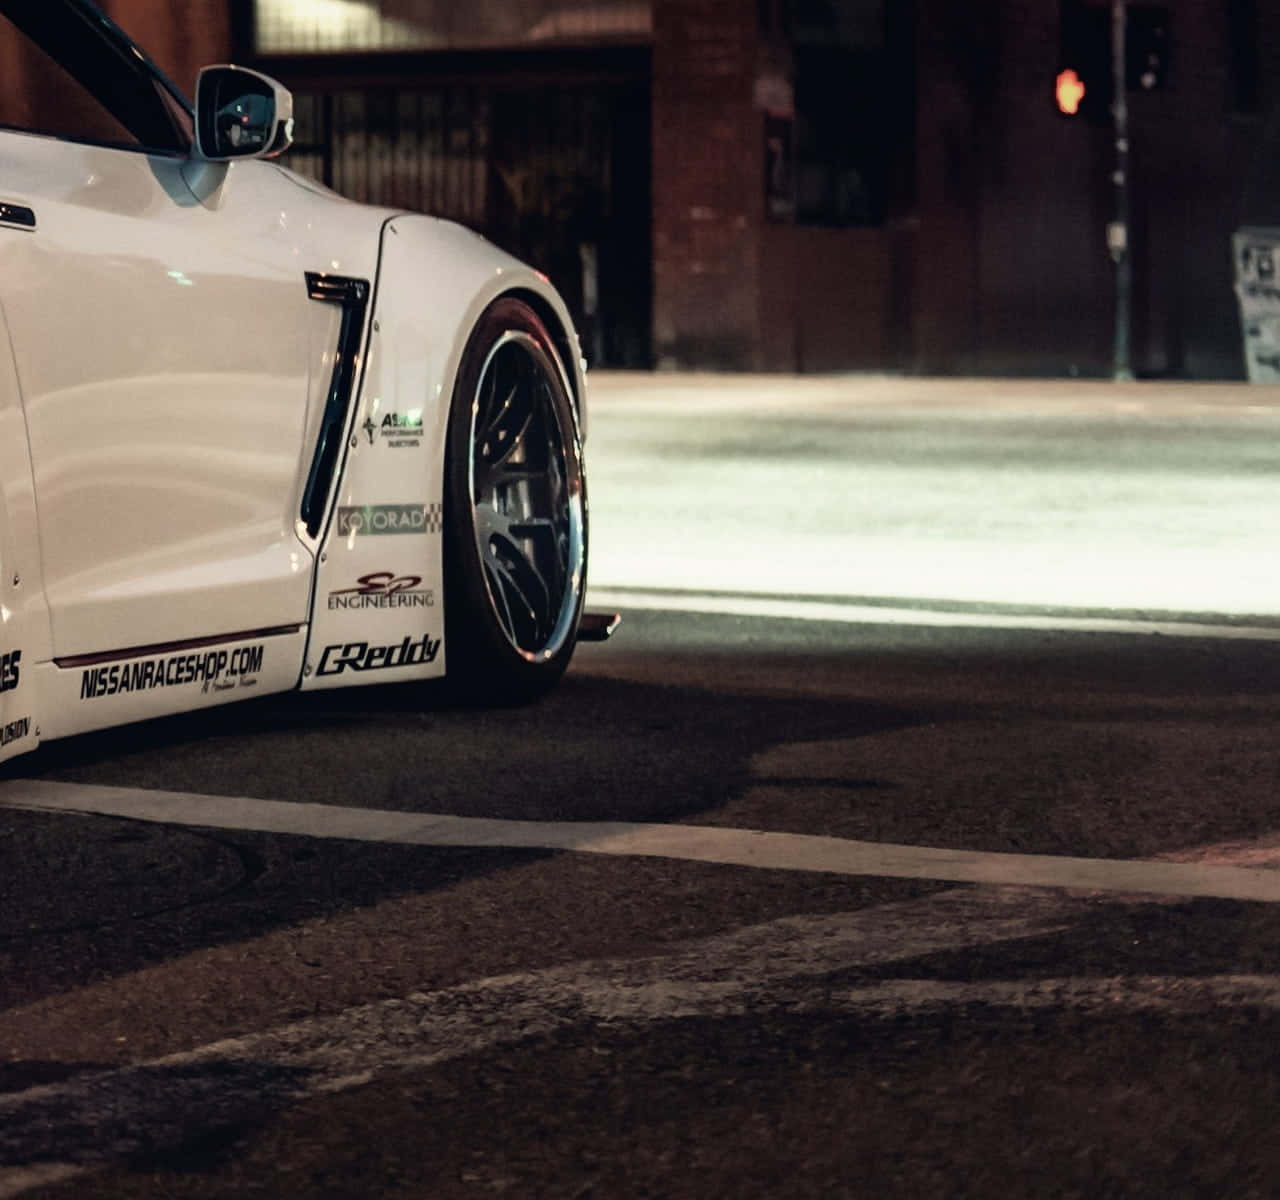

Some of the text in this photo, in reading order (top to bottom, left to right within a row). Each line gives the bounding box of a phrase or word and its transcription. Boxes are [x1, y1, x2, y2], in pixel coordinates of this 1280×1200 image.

[340, 509, 424, 530] KOYORAD
[328, 593, 435, 610] ENGINEERING
[80, 645, 264, 700] NISSANRACESHOP.COM
